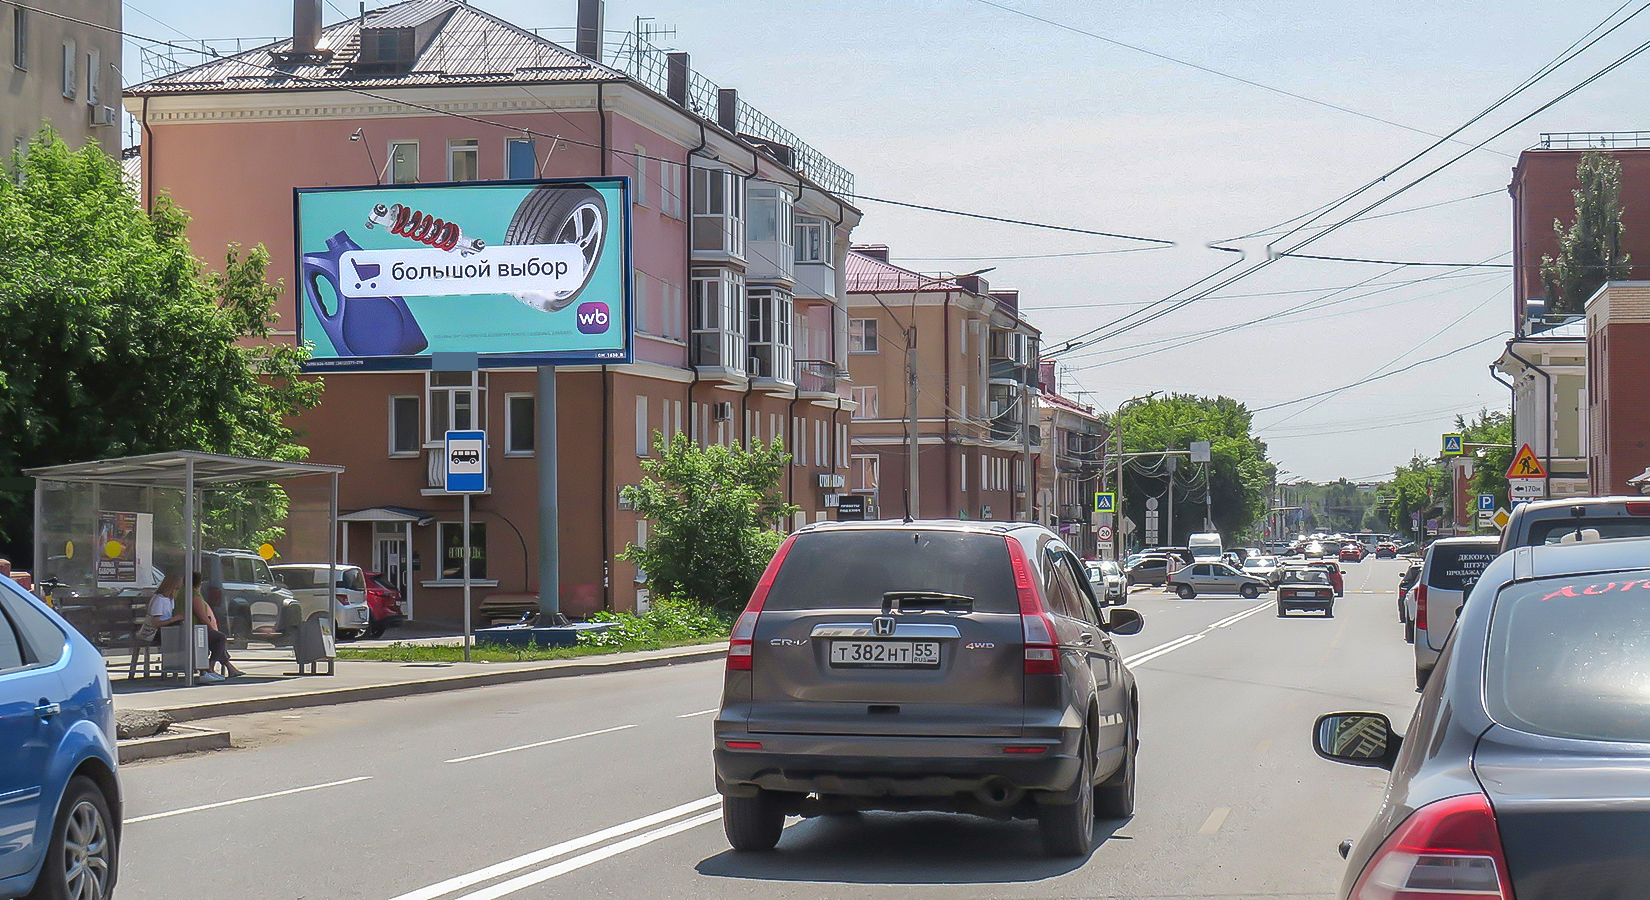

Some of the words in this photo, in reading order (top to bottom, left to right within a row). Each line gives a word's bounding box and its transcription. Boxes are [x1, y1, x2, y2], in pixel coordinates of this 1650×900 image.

[392, 259, 491, 281] большой
[498, 258, 568, 281] выбор
[578, 309, 608, 326] wb
[1483, 497, 1491, 508] P
[770, 638, 809, 646] CR-V
[914, 643, 933, 657] 55
